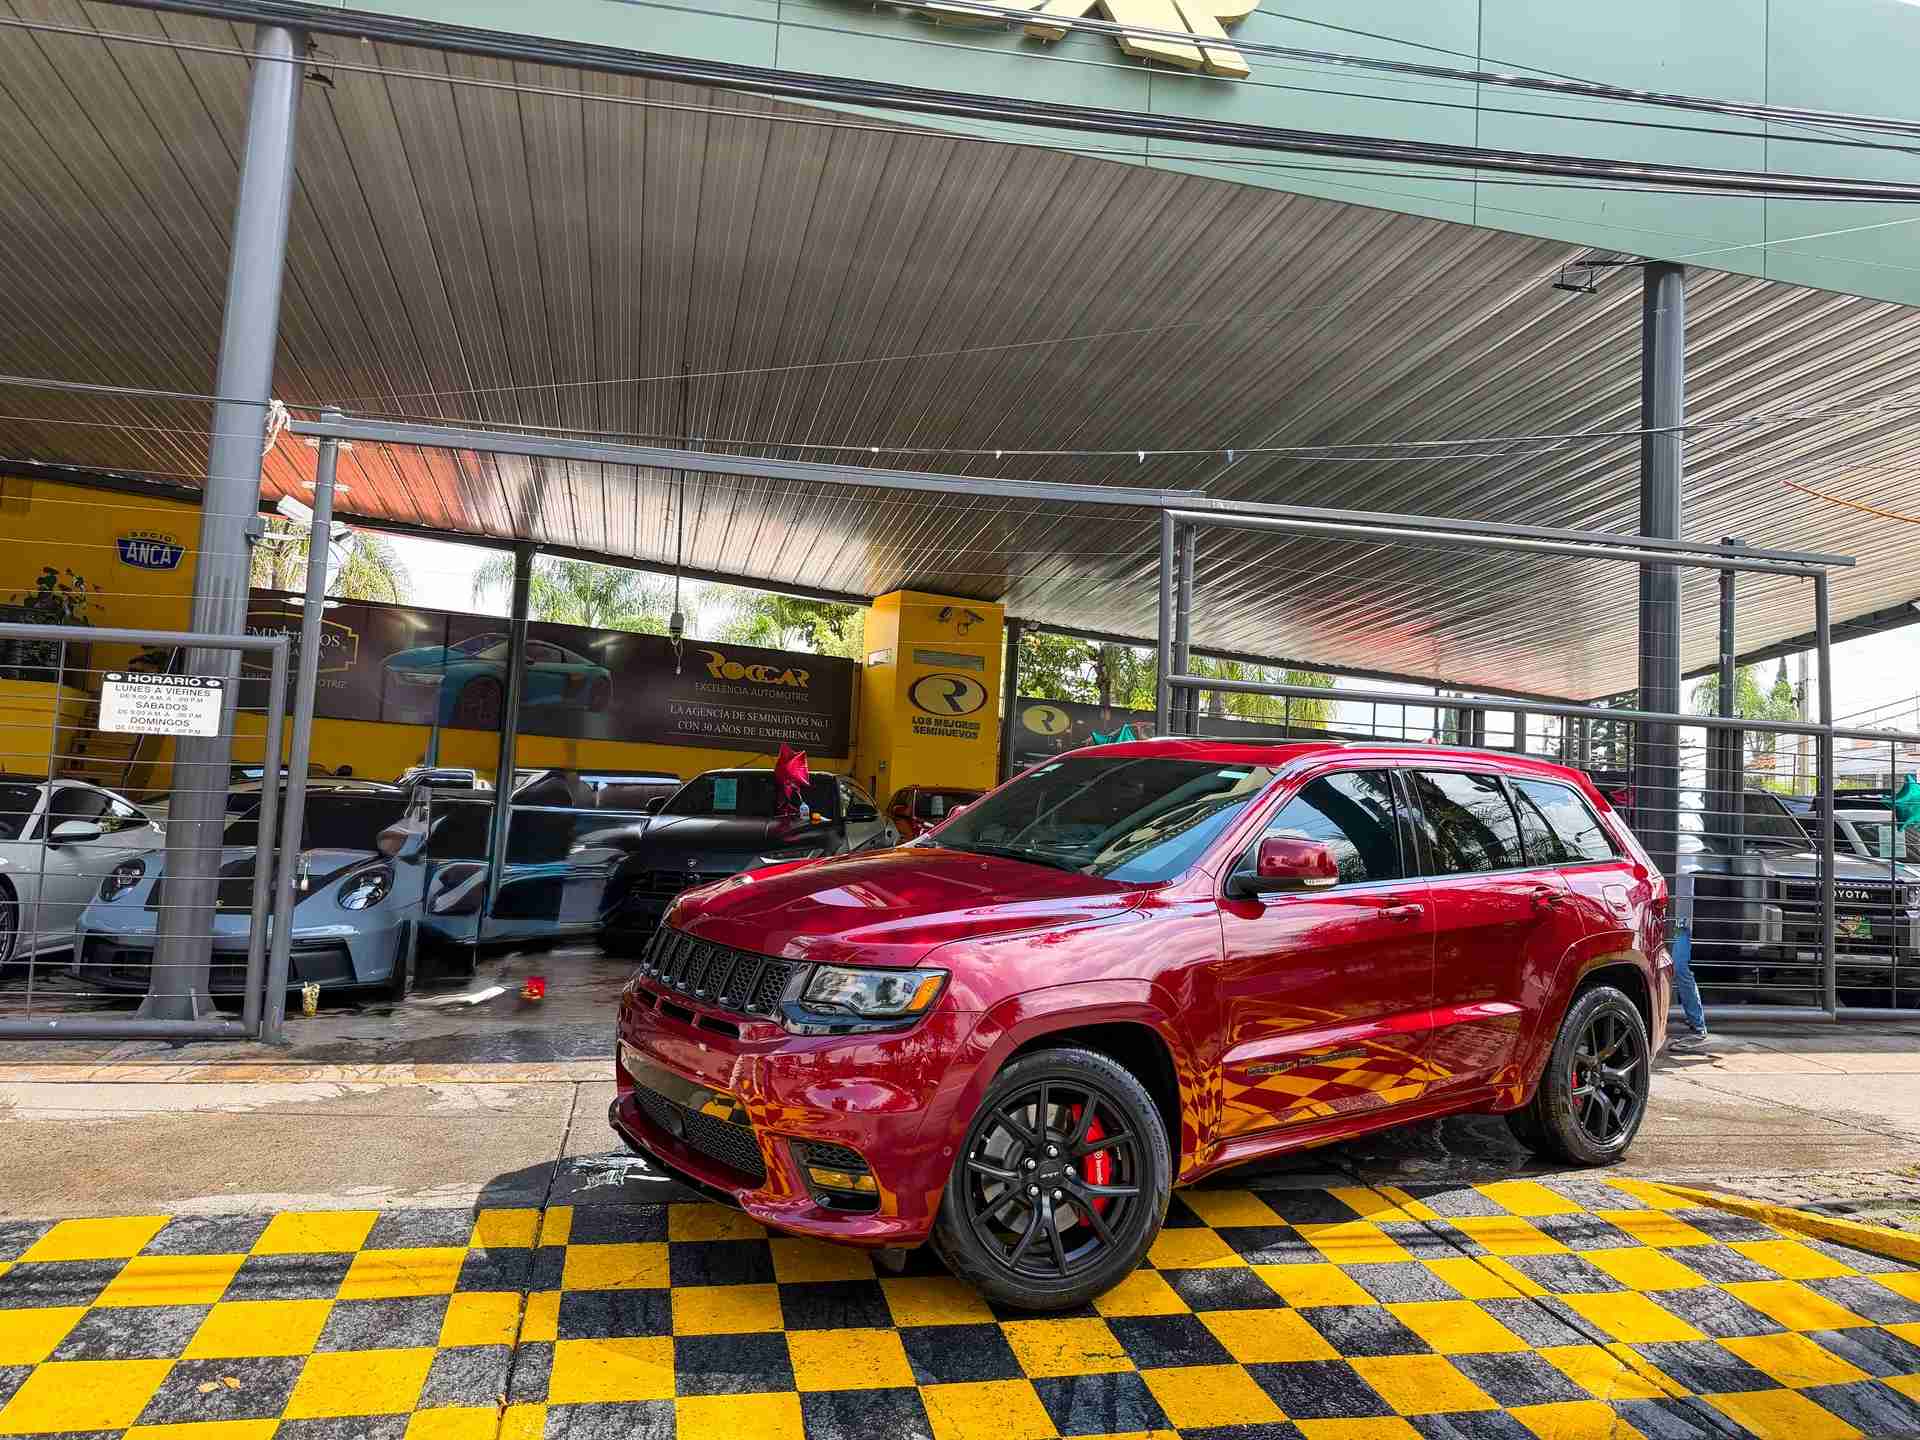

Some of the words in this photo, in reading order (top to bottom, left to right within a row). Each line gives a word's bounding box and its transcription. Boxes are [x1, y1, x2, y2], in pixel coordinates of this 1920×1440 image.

[126, 541, 172, 564] ANCA
[127, 674, 201, 687] HORARIO
[114, 684, 151, 694] LUNES
[154, 686, 162, 694] A
[166, 687, 211, 697] VIERNES
[130, 716, 191, 727] DOMINGOS
[670, 704, 683, 715] LA
[685, 706, 730, 721] AGENCIA
[732, 710, 746, 721] DE
[747, 712, 809, 727] SEMINUEVOS
[912, 716, 932, 726] LOS
[678, 720, 701, 731] CON
[743, 726, 756, 737] DE
[758, 727, 821, 742] EXPERIENCIA
[912, 726, 978, 739] SEMINUEVOS
[1833, 890, 1869, 899] YOTA
